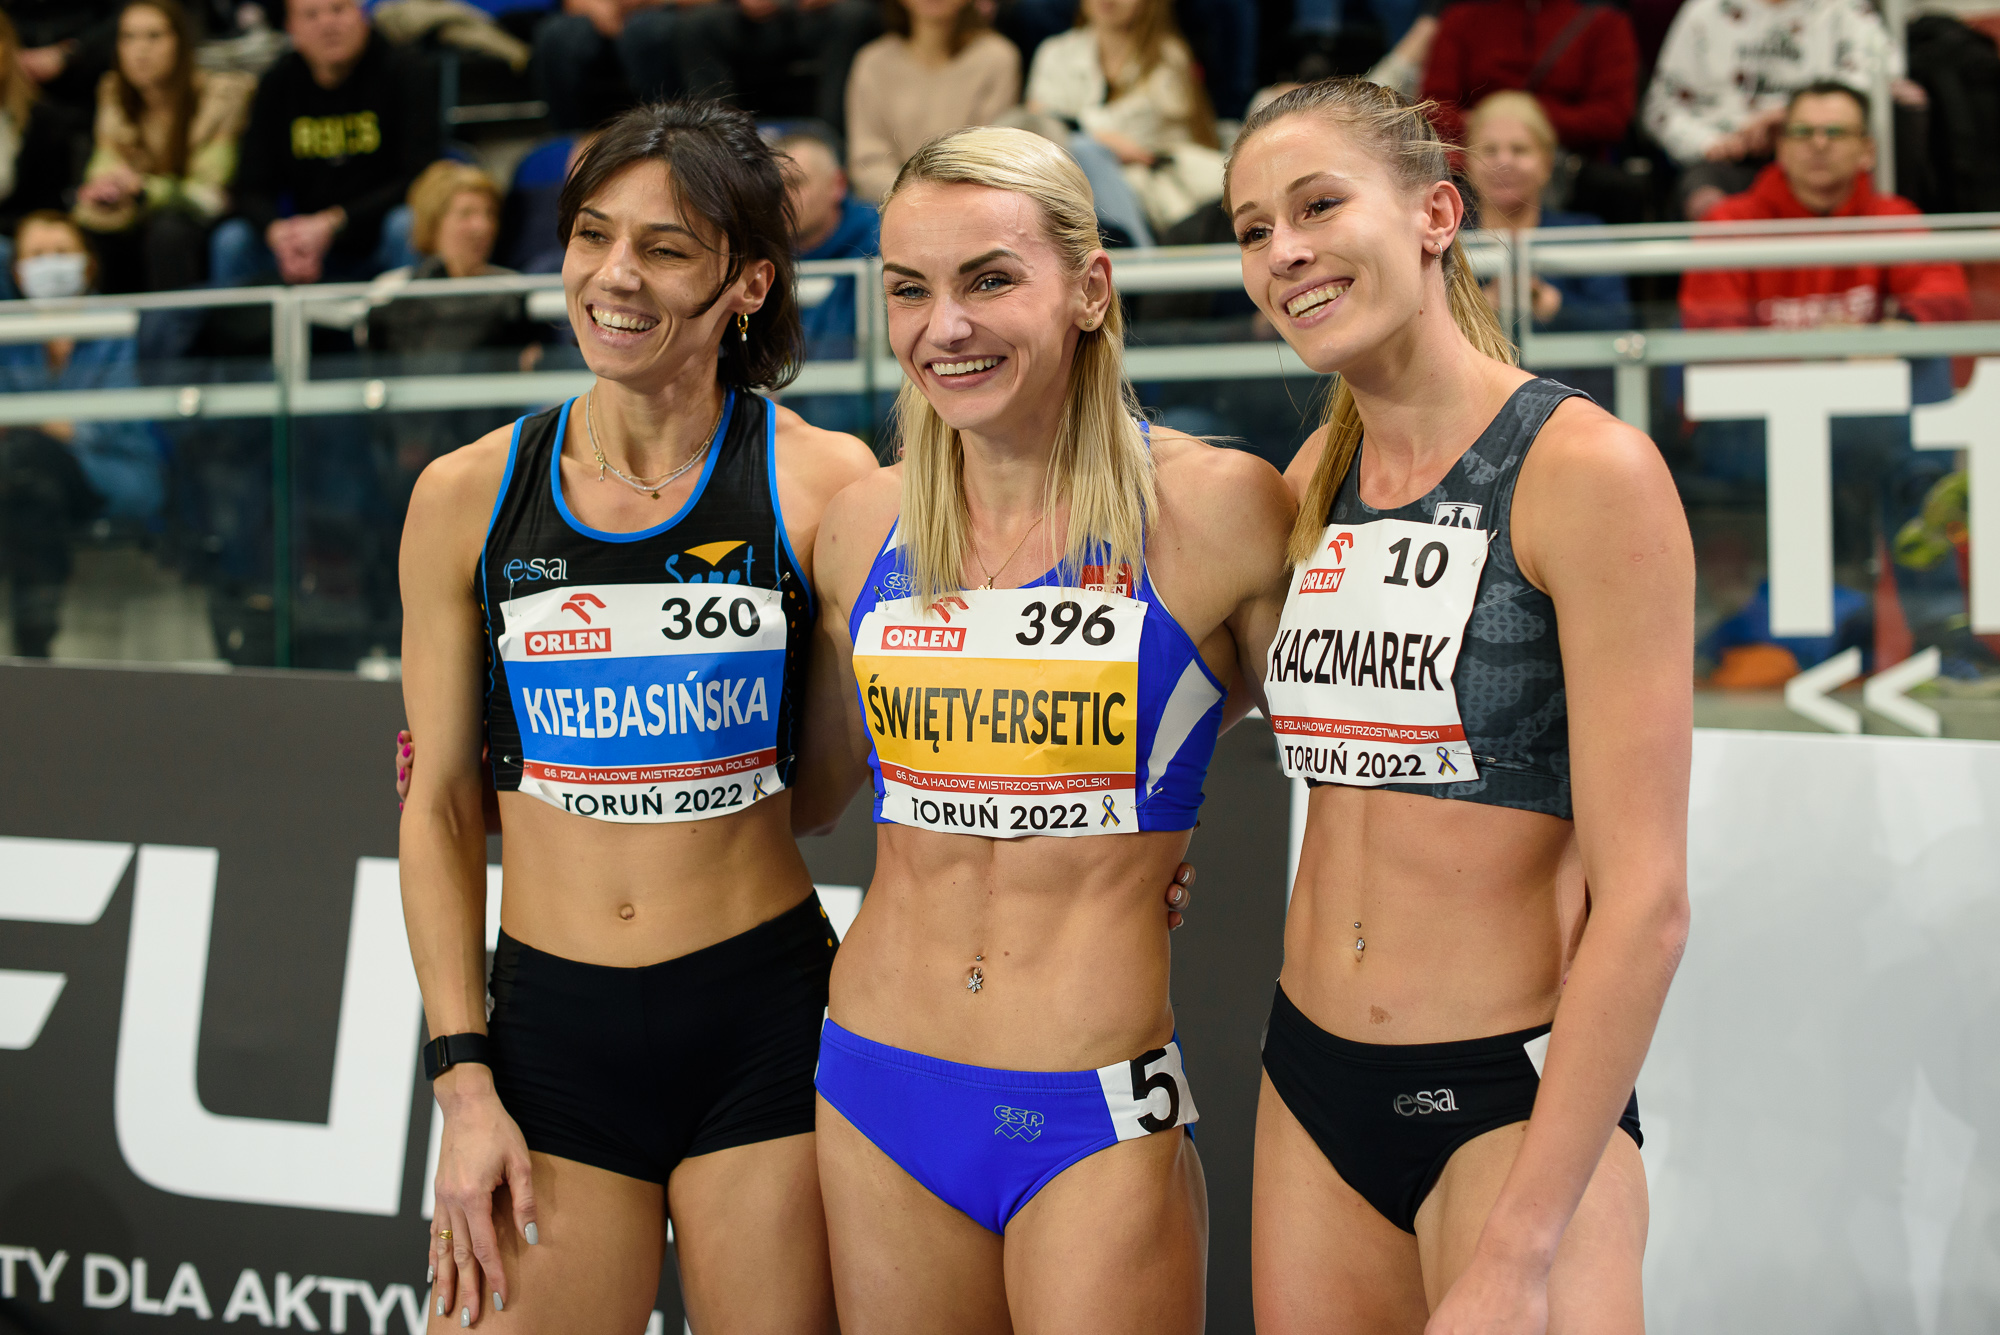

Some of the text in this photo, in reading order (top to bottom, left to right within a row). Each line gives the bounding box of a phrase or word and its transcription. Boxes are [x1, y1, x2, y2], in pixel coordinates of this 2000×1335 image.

[1301, 570, 1343, 591] ORLEN
[1383, 537, 1449, 589] 10
[1088, 585, 1124, 594] OREN
[661, 596, 761, 641] 360
[1015, 601, 1116, 647] 396
[528, 631, 607, 653] ORLEN
[885, 628, 962, 649] ORLEN
[1270, 628, 1451, 691] KACZMAREK
[522, 670, 769, 739] KIEŁBASIŃSKA
[867, 674, 1126, 753] ŚWIĘTY-ERSETIC
[1284, 720, 1301, 731] PZLA
[1301, 722, 1332, 733] HALOWE
[1333, 724, 1400, 739] MISTRZOSTWA
[1400, 729, 1440, 740] POLSKI
[543, 756, 760, 781] 66. PZLA HALOWE MISTRZOSTWA POLSKI
[1285, 741, 1427, 779] TORUŃ 2022
[896, 769, 1110, 791] 66. PZLA HALOWE MISTRZOSTWA POLSKI
[562, 783, 743, 816] TORUŃ 2022
[911, 797, 1089, 830] TORUŃ 2022
[1130, 1048, 1180, 1134] 5
[83, 1252, 214, 1320] DLA
